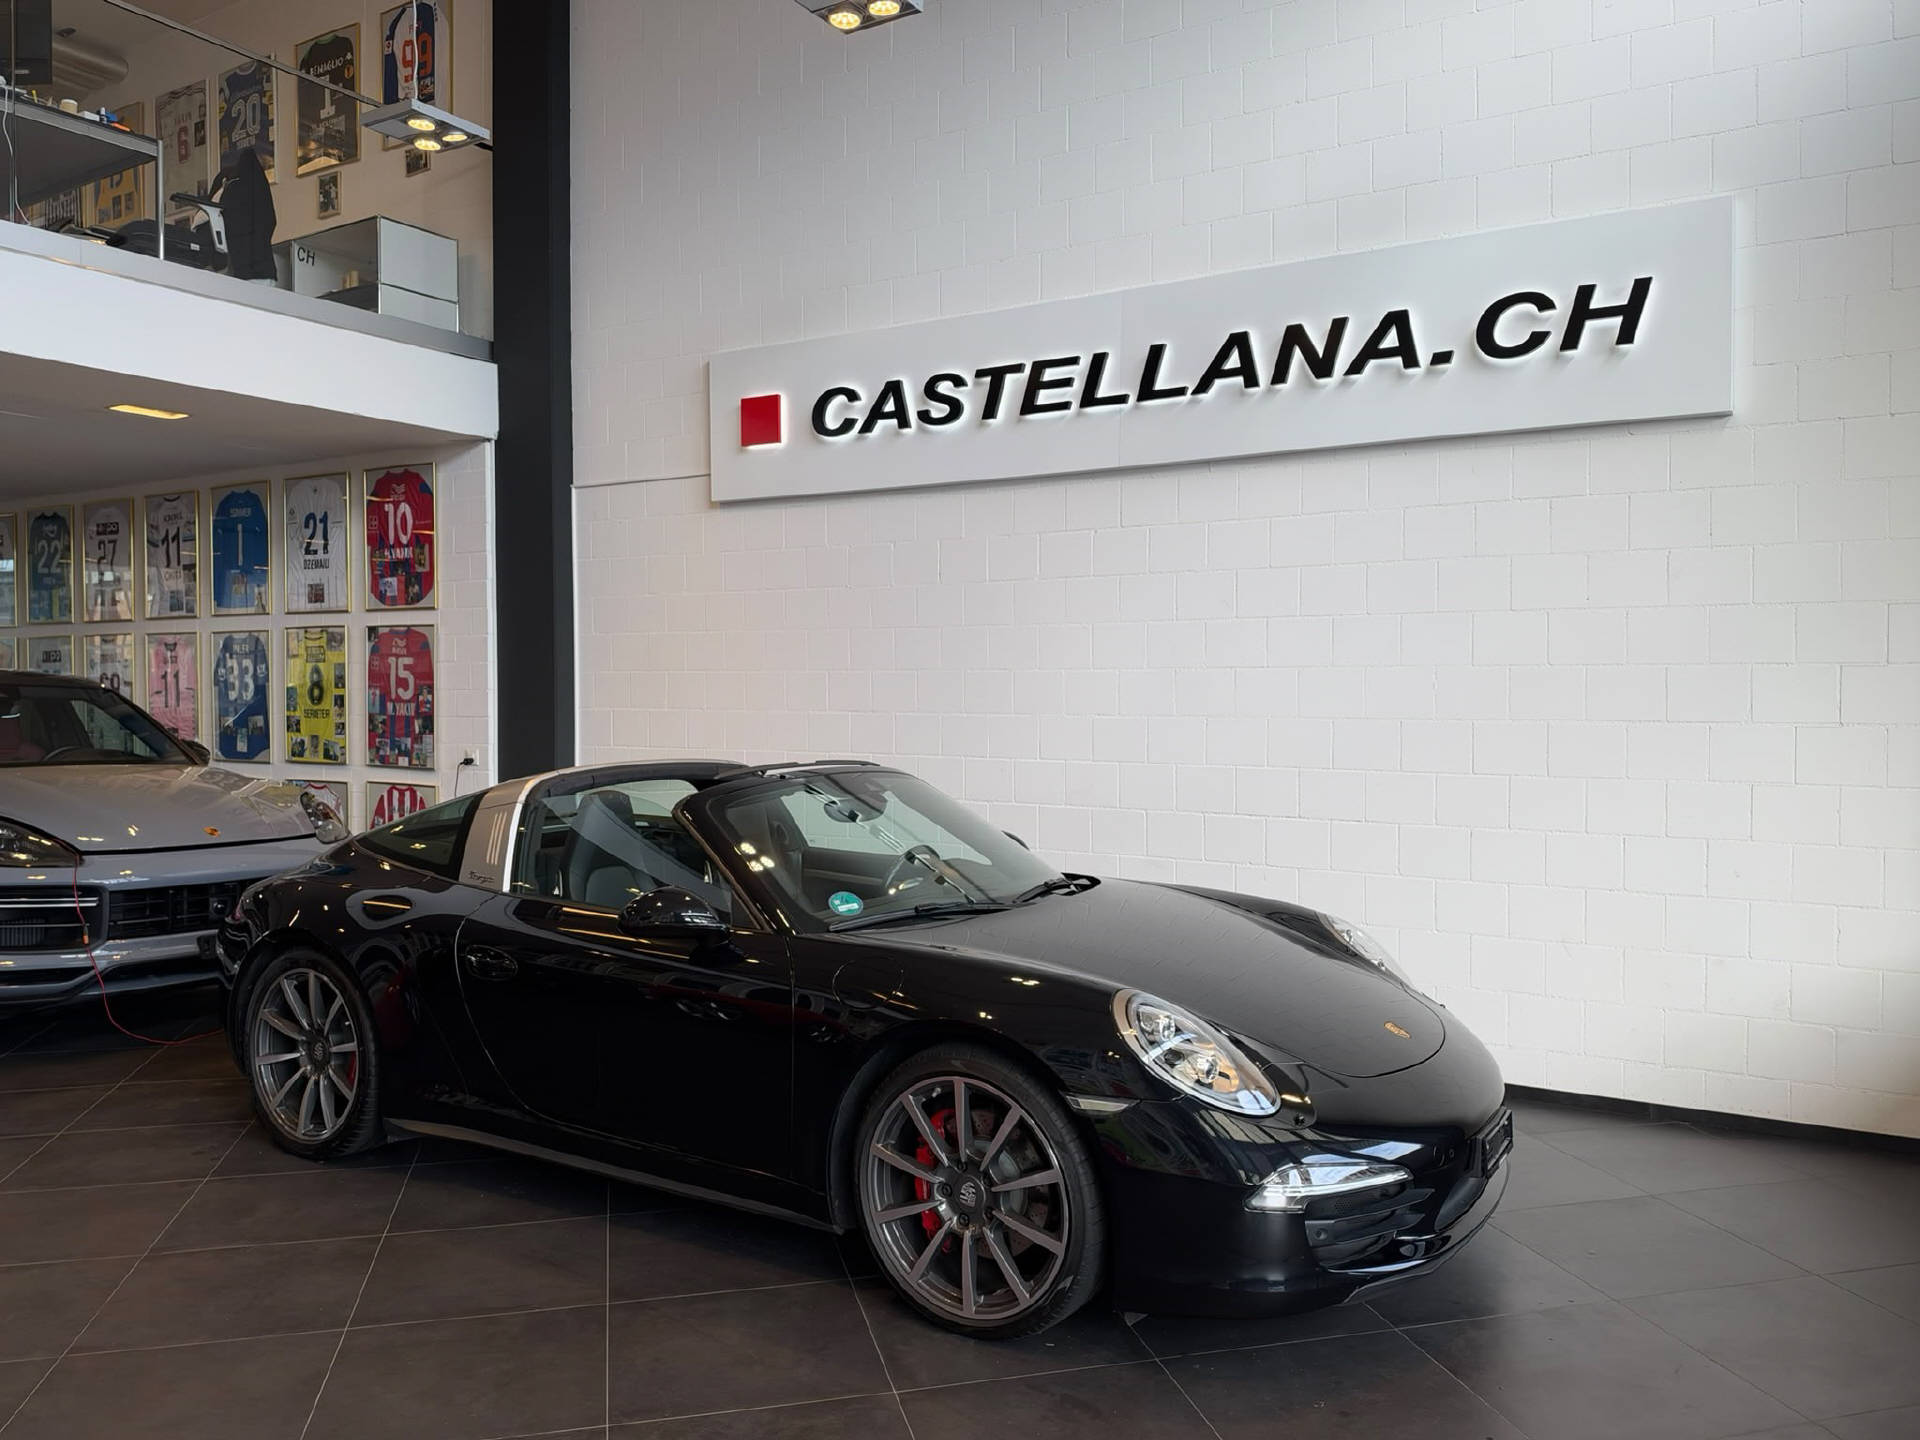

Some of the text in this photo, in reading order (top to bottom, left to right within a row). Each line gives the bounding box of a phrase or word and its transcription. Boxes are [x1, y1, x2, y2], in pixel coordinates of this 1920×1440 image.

[402, 32, 432, 84] 99
[231, 93, 261, 142] 20
[297, 246, 315, 267] CH
[811, 277, 1653, 437] CASTELLANA.CH
[304, 510, 329, 555] 21
[384, 502, 413, 544] 10
[37, 539, 61, 574] 22
[97, 539, 117, 574] 27
[161, 526, 181, 568] 11
[237, 523, 244, 566] 1
[161, 670, 180, 708] 11
[226, 657, 255, 701] 33
[308, 664, 324, 706] 8
[388, 657, 415, 701] 15
